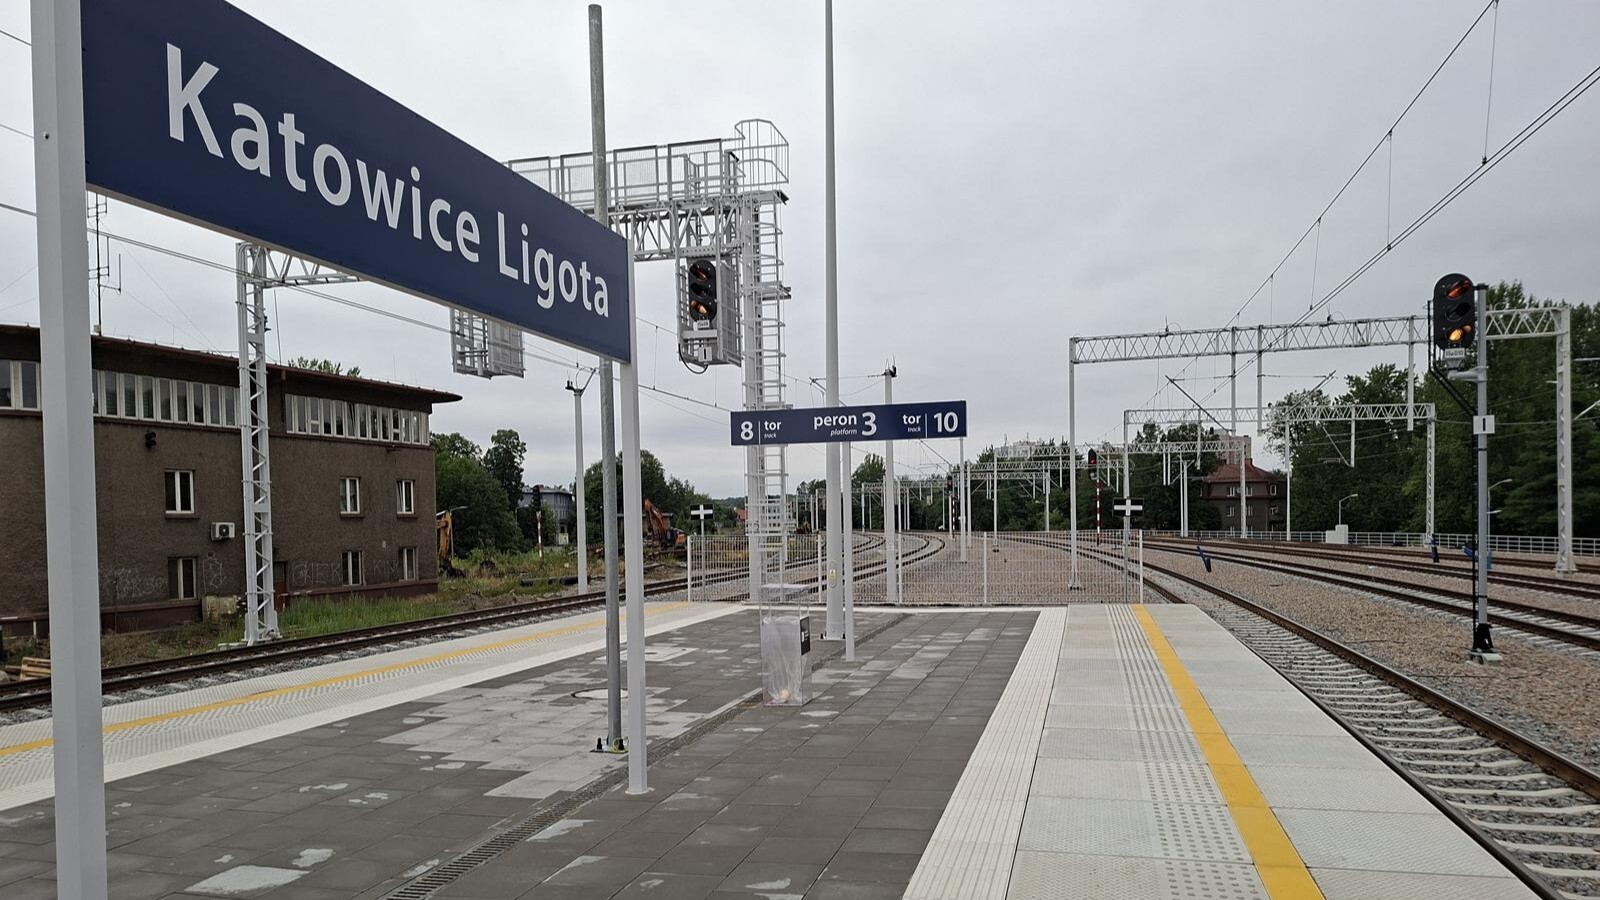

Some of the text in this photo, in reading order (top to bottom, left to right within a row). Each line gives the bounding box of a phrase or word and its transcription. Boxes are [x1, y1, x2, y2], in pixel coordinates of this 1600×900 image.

[166, 42, 609, 318] Katowice Ligota
[740, 420, 781, 441] 8 tor
[813, 411, 877, 436] peron 3
[830, 428, 858, 437] platform
[903, 412, 959, 433] tor 10
